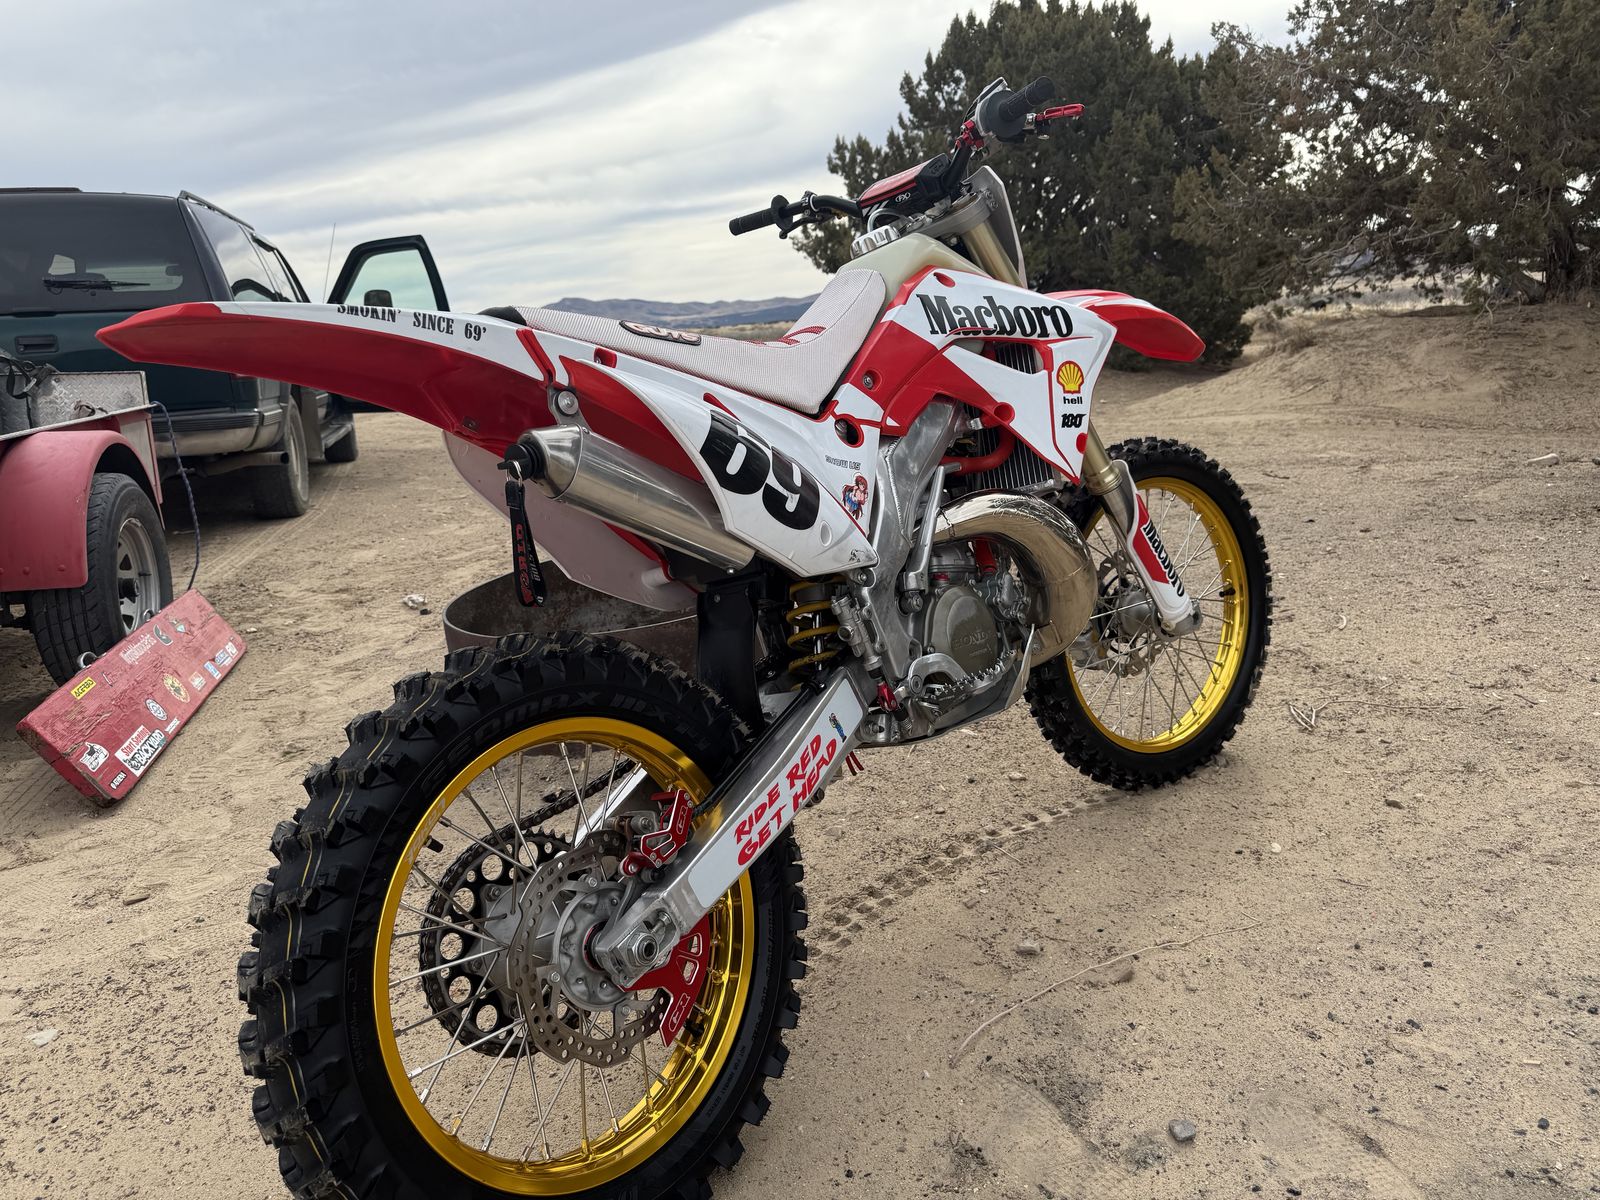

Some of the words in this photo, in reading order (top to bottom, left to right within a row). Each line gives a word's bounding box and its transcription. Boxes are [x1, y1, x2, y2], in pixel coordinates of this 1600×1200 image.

[413, 311, 454, 335] SINCE
[916, 293, 1074, 338] Macboro
[1063, 396, 1083, 405] hell
[699, 410, 821, 531] 69
[734, 783, 781, 844] RIDE
[786, 735, 821, 790] RED
[738, 804, 787, 866] GET
[792, 739, 837, 812] HEAD
